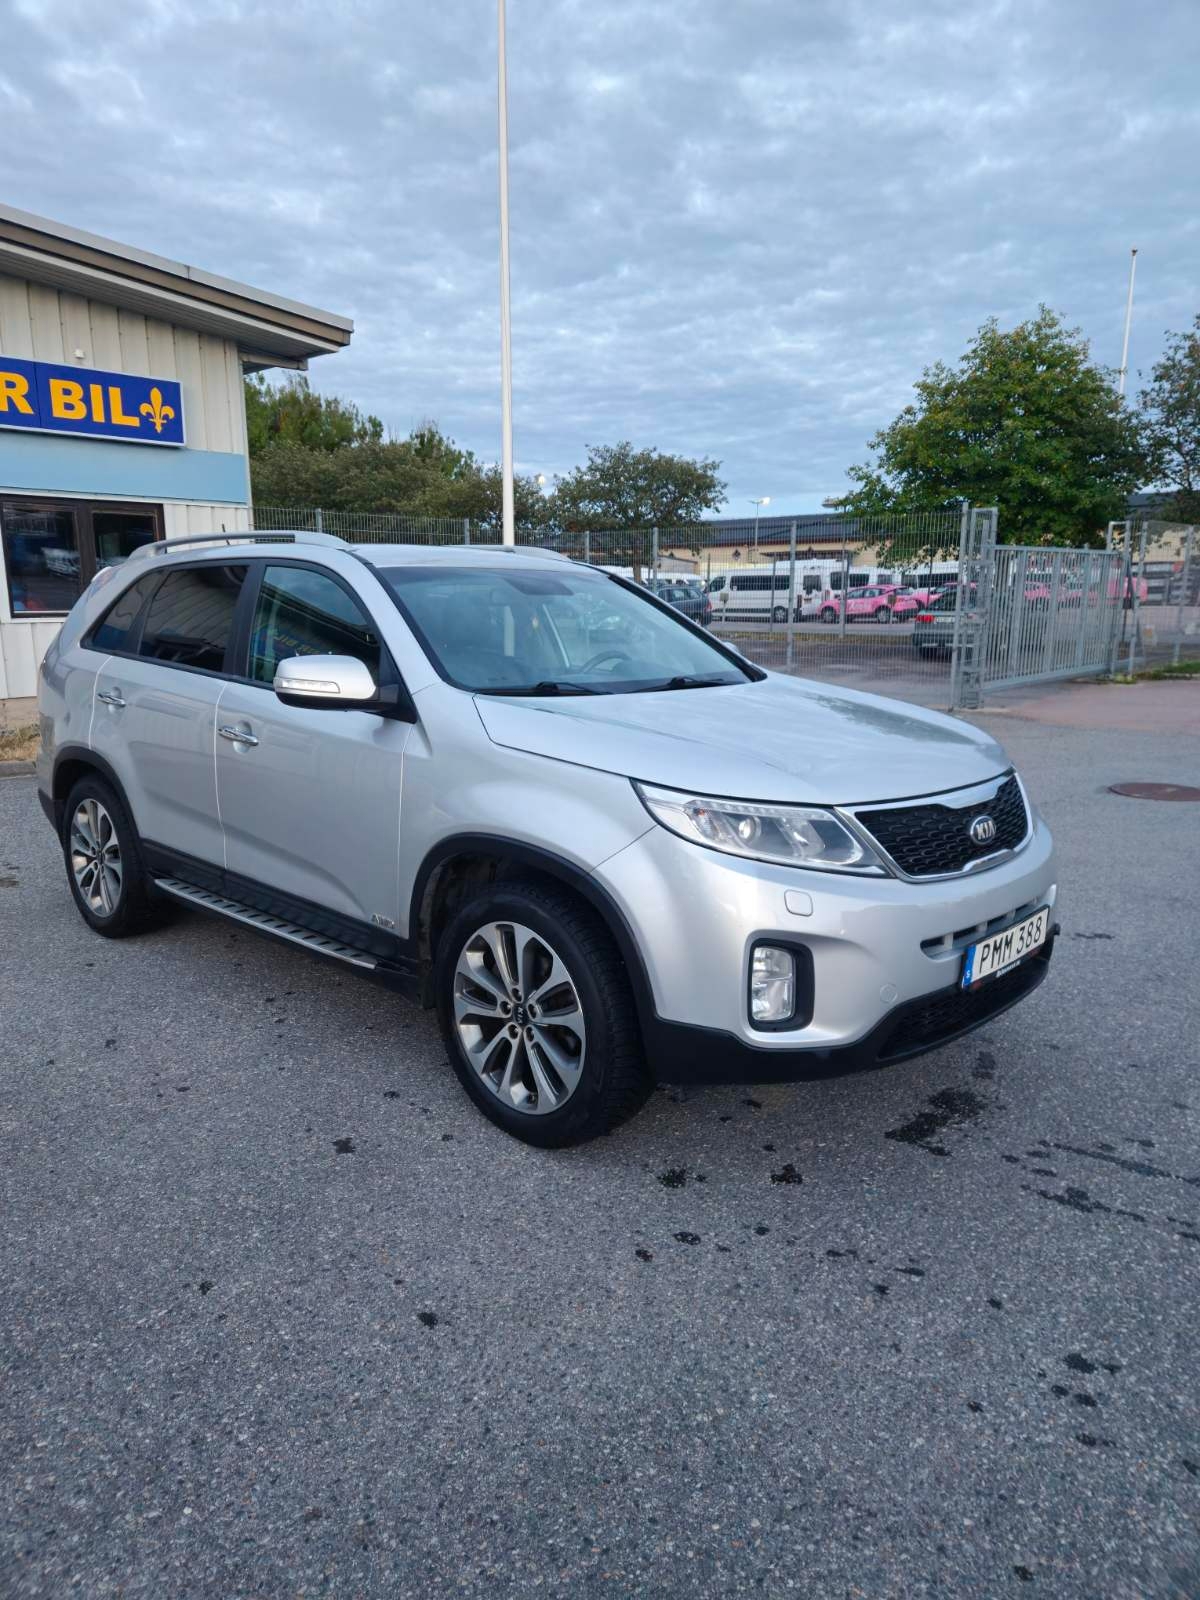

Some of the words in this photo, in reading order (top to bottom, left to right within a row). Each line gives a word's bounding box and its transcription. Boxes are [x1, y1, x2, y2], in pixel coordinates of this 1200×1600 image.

[49, 378, 140, 427] BIL
[979, 932, 1014, 975] PMM
[1016, 916, 1043, 954] 388
